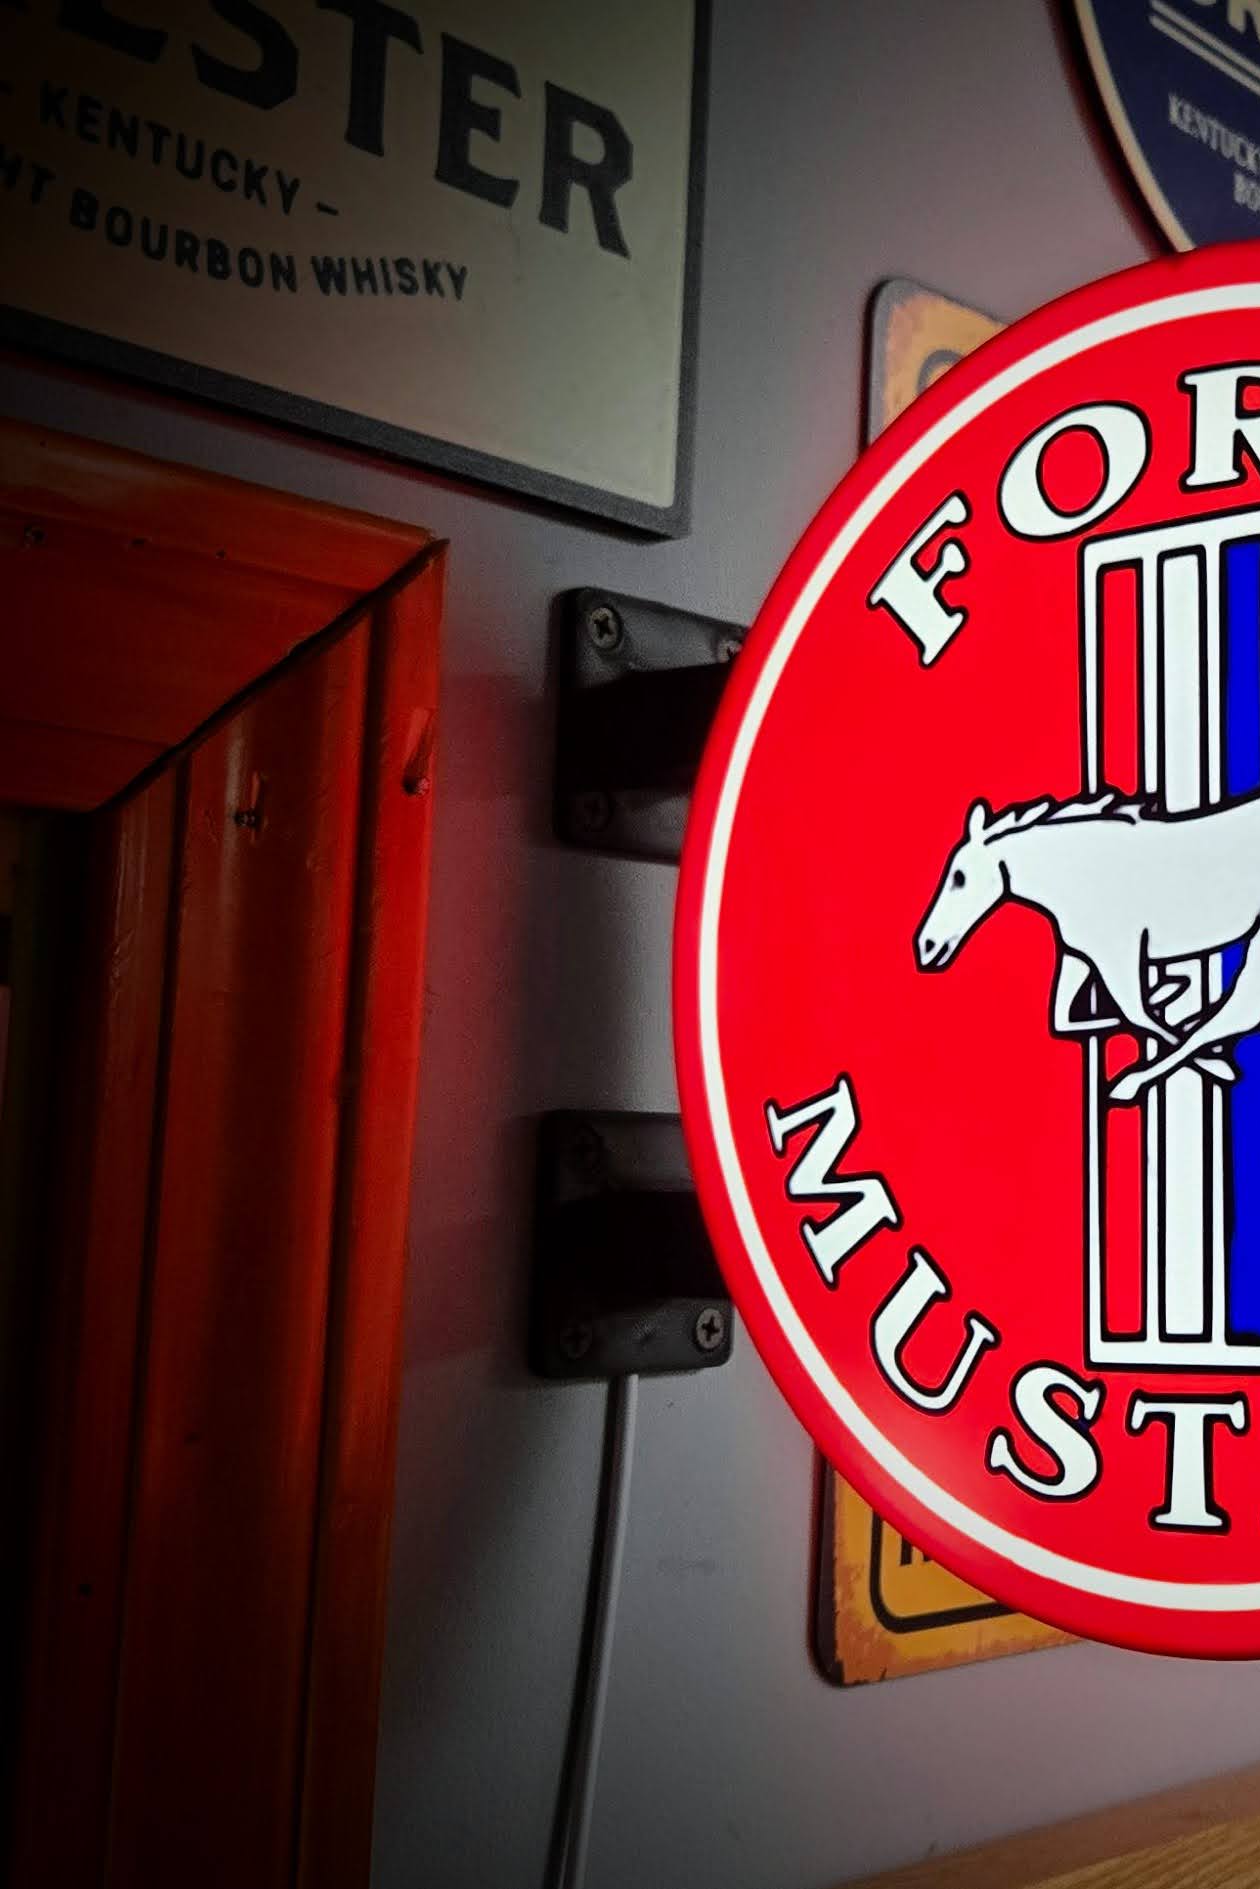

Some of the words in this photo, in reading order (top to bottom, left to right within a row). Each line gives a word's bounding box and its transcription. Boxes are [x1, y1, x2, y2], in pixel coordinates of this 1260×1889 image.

[40, 80, 300, 215] KENTUCKY
[70, 187, 297, 293] BOURBON
[311, 255, 468, 301] WHISKY
